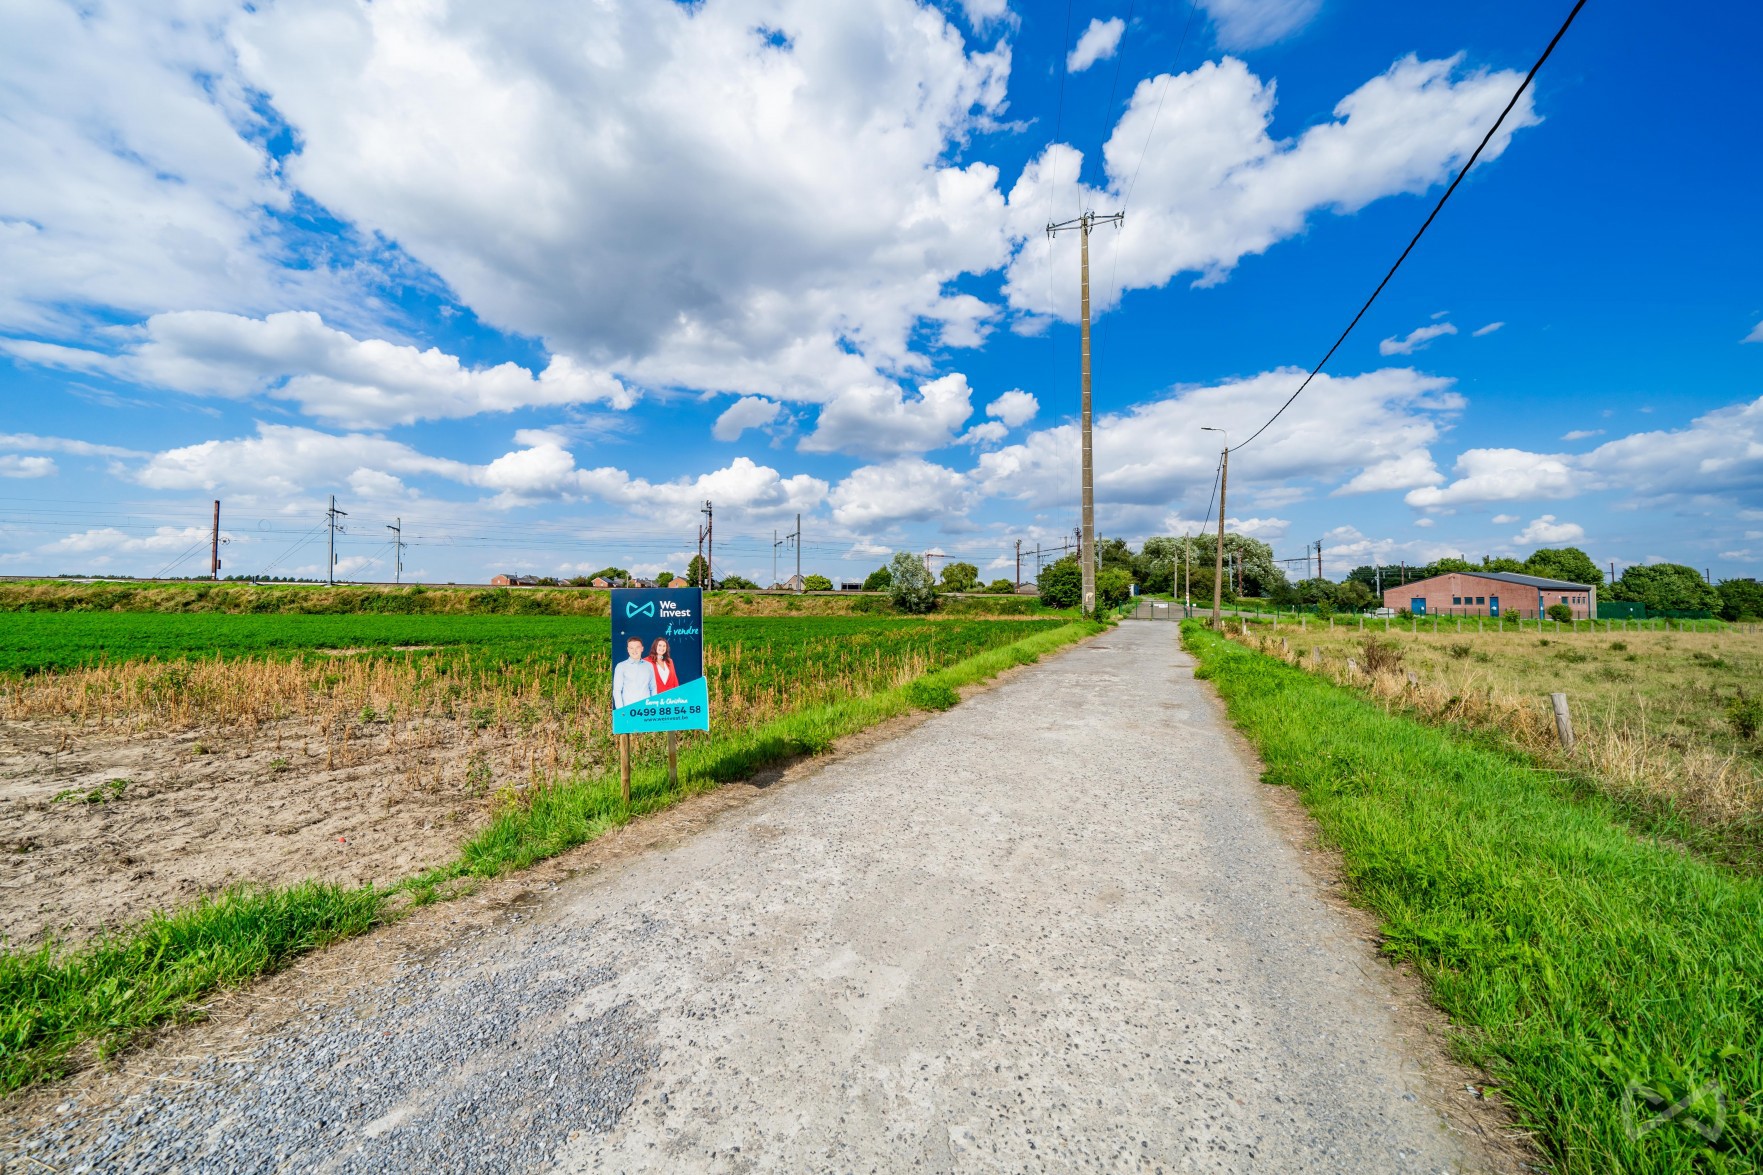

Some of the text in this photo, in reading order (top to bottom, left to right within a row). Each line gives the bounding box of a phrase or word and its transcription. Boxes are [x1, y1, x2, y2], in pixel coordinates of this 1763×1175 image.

[660, 601, 676, 609] We
[660, 609, 691, 617] Invest
[673, 626, 699, 635] vendre
[629, 705, 701, 717] 0499 88 54 58
